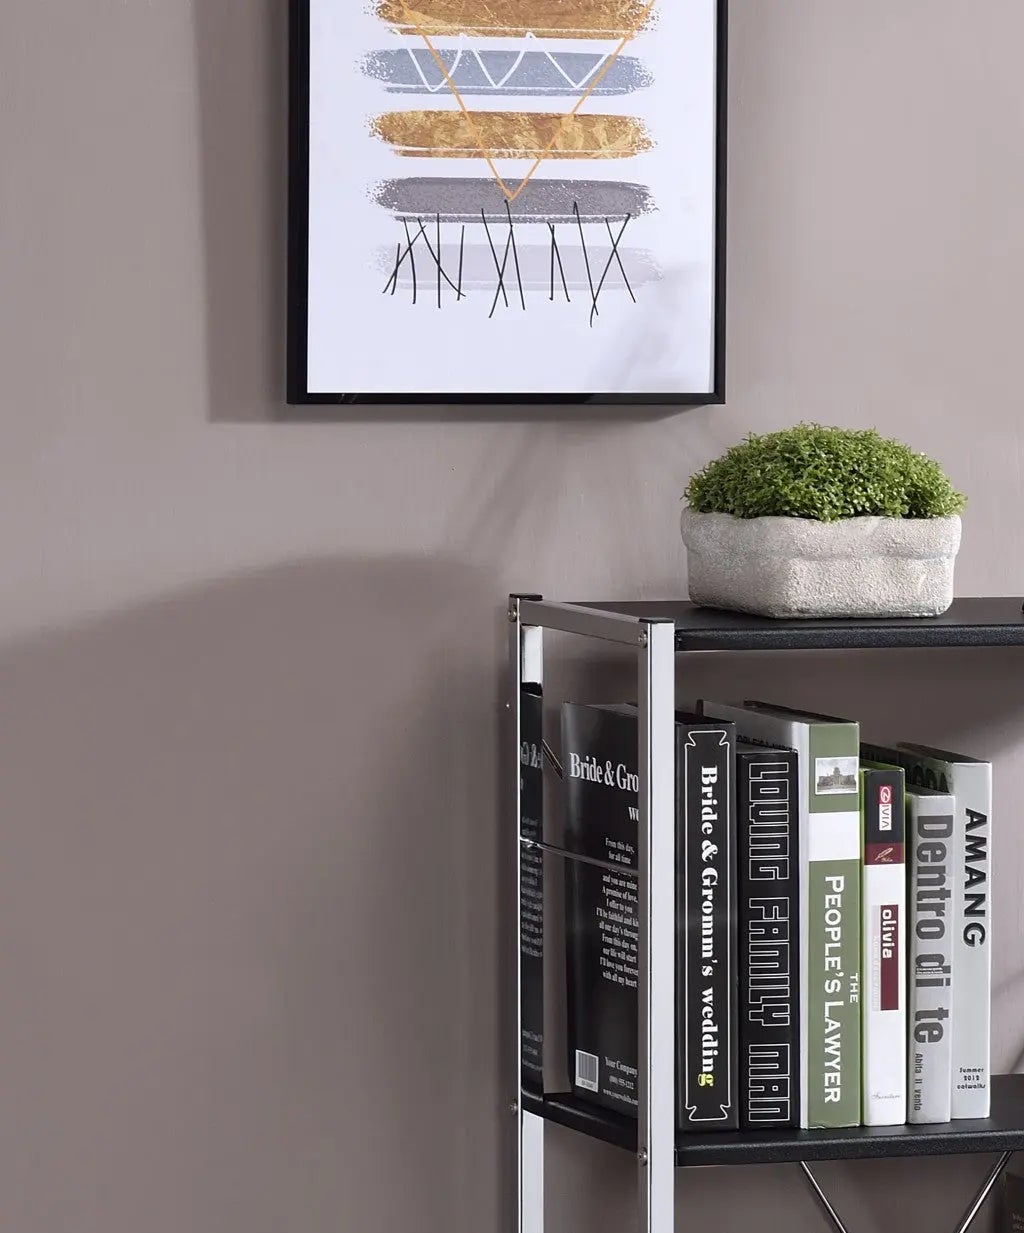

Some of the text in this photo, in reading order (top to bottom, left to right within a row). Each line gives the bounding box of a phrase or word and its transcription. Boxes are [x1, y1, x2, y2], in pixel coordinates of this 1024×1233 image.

[569, 752, 603, 784] Bride
[604, 760, 615, 787] &
[748, 762, 790, 881] LOVING
[698, 765, 719, 1087] Bride & Gromm's wedding
[915, 815, 953, 940] Dentro
[963, 807, 988, 948] AMANG
[748, 897, 791, 1027] FAMILY
[882, 909, 897, 959] olivia
[915, 953, 951, 988] di
[824, 875, 845, 1104] PEOPLE'S LAWYER
[849, 973, 859, 1004] THE
[913, 1007, 950, 1044] te
[748, 1043, 791, 1122] MAN
